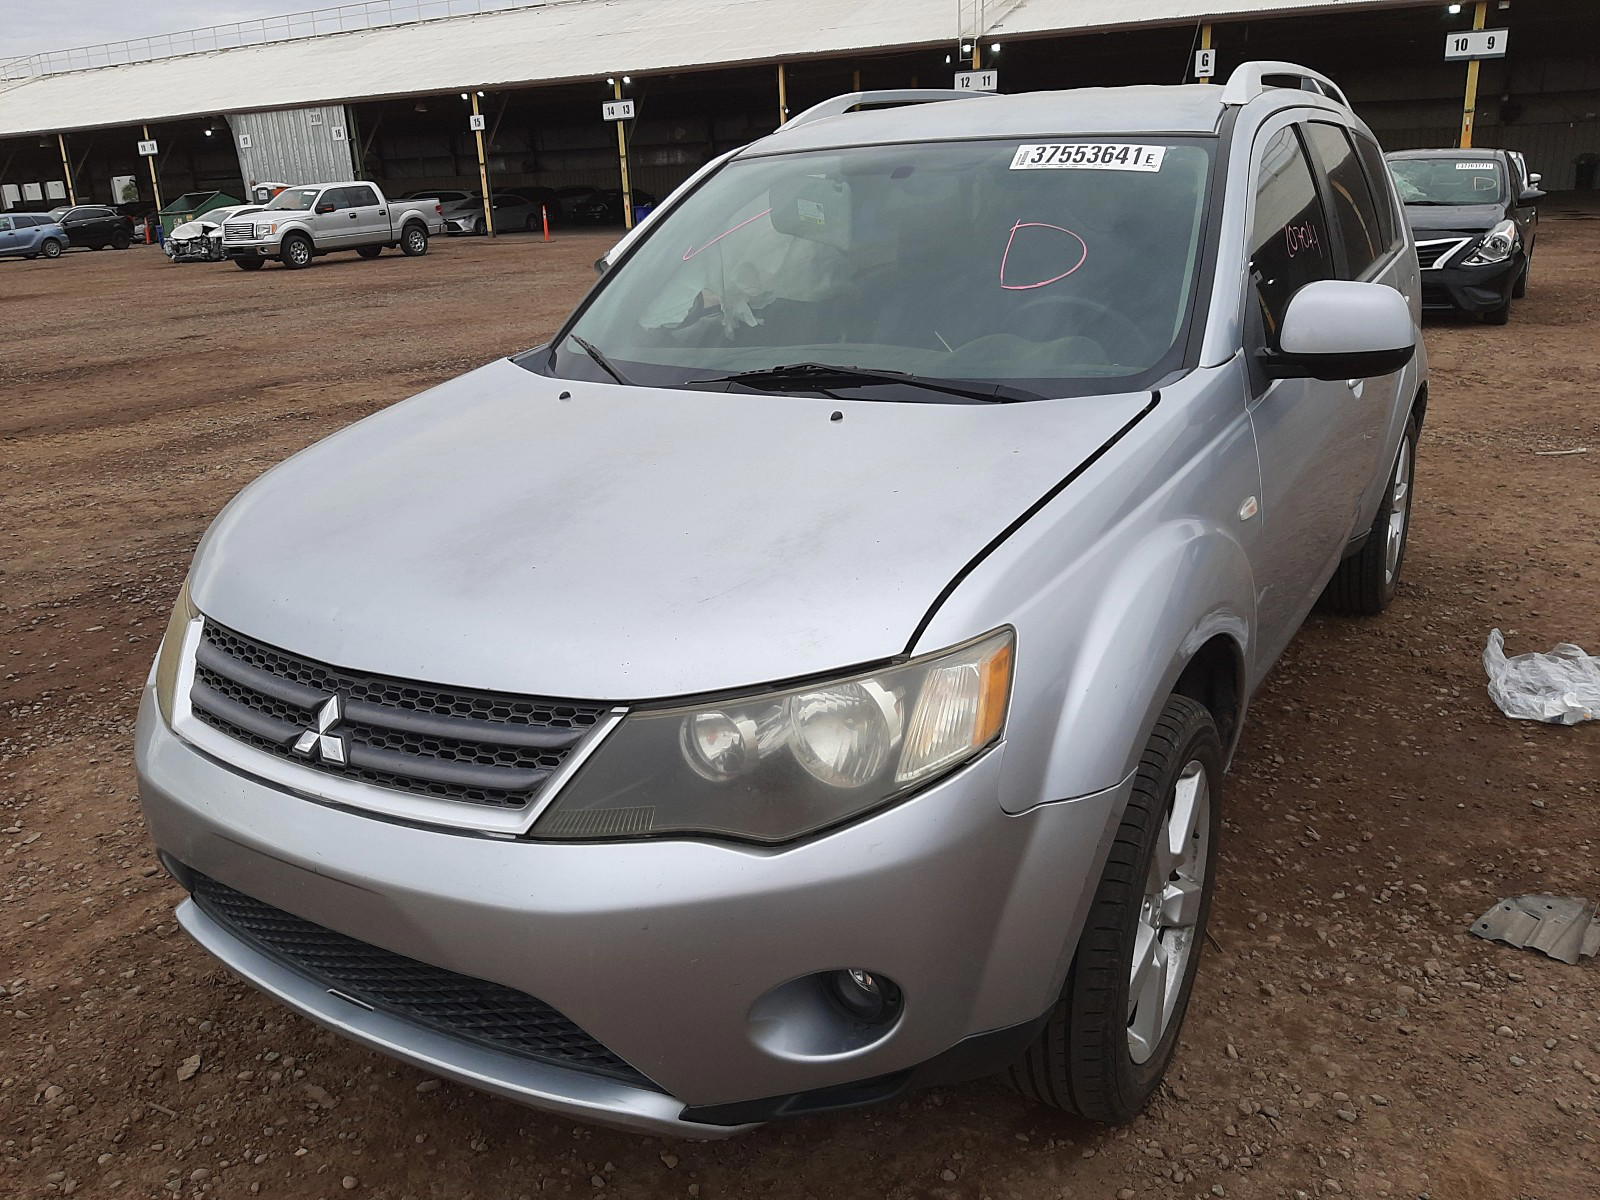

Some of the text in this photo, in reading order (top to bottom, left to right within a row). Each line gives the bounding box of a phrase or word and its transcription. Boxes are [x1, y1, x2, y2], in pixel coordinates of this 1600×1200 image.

[1454, 36, 1496, 52] 10 9
[1200, 53, 1209, 67] G
[960, 75, 991, 88] 12 11
[607, 104, 630, 116] 14 13
[474, 117, 481, 127] 15
[1030, 145, 1143, 165] 37553641
[1145, 153, 1155, 164] E
